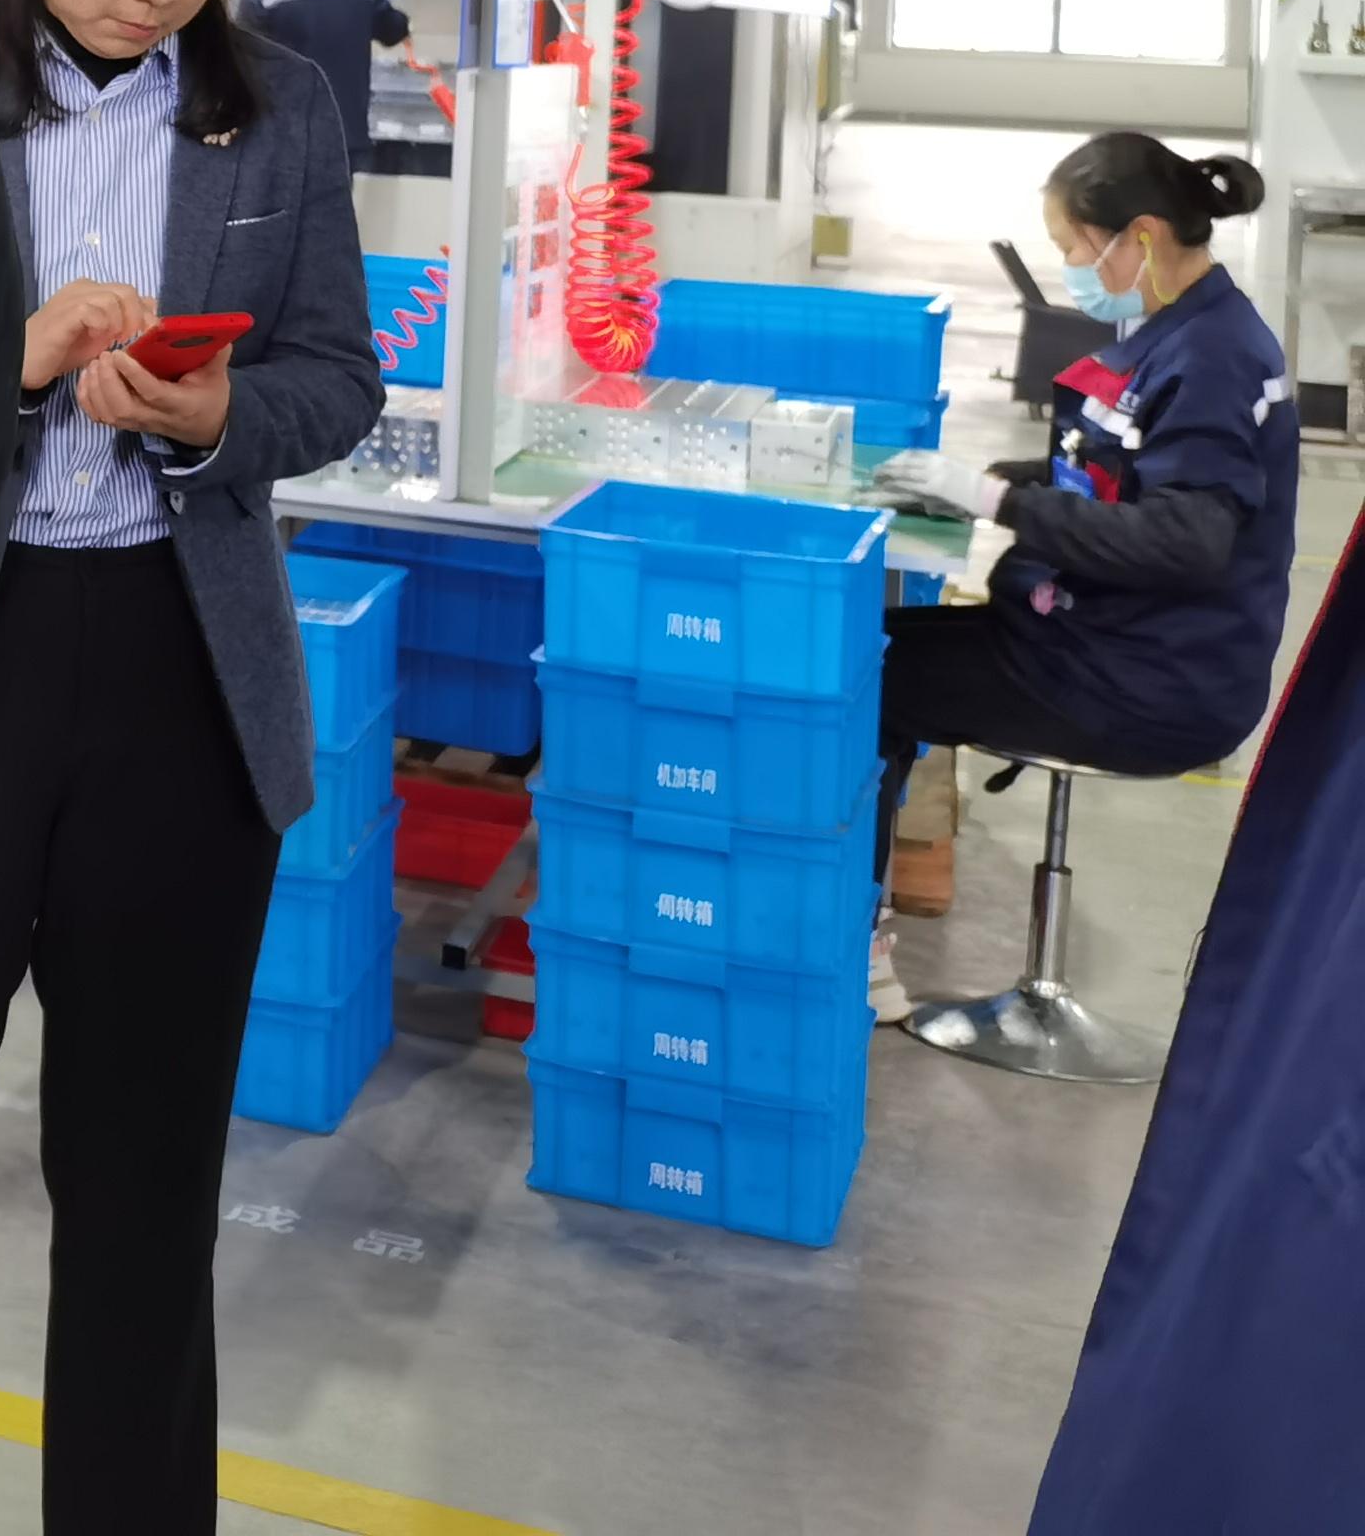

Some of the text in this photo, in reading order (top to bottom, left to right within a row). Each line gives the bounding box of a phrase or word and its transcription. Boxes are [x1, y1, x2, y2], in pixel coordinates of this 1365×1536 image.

[666, 613, 722, 644] 周转箱
[656, 762, 718, 795] 机加车间
[656, 892, 714, 927] 周转箱
[653, 1032, 709, 1066] 周转箱
[648, 1162, 703, 1196] 周转箱
